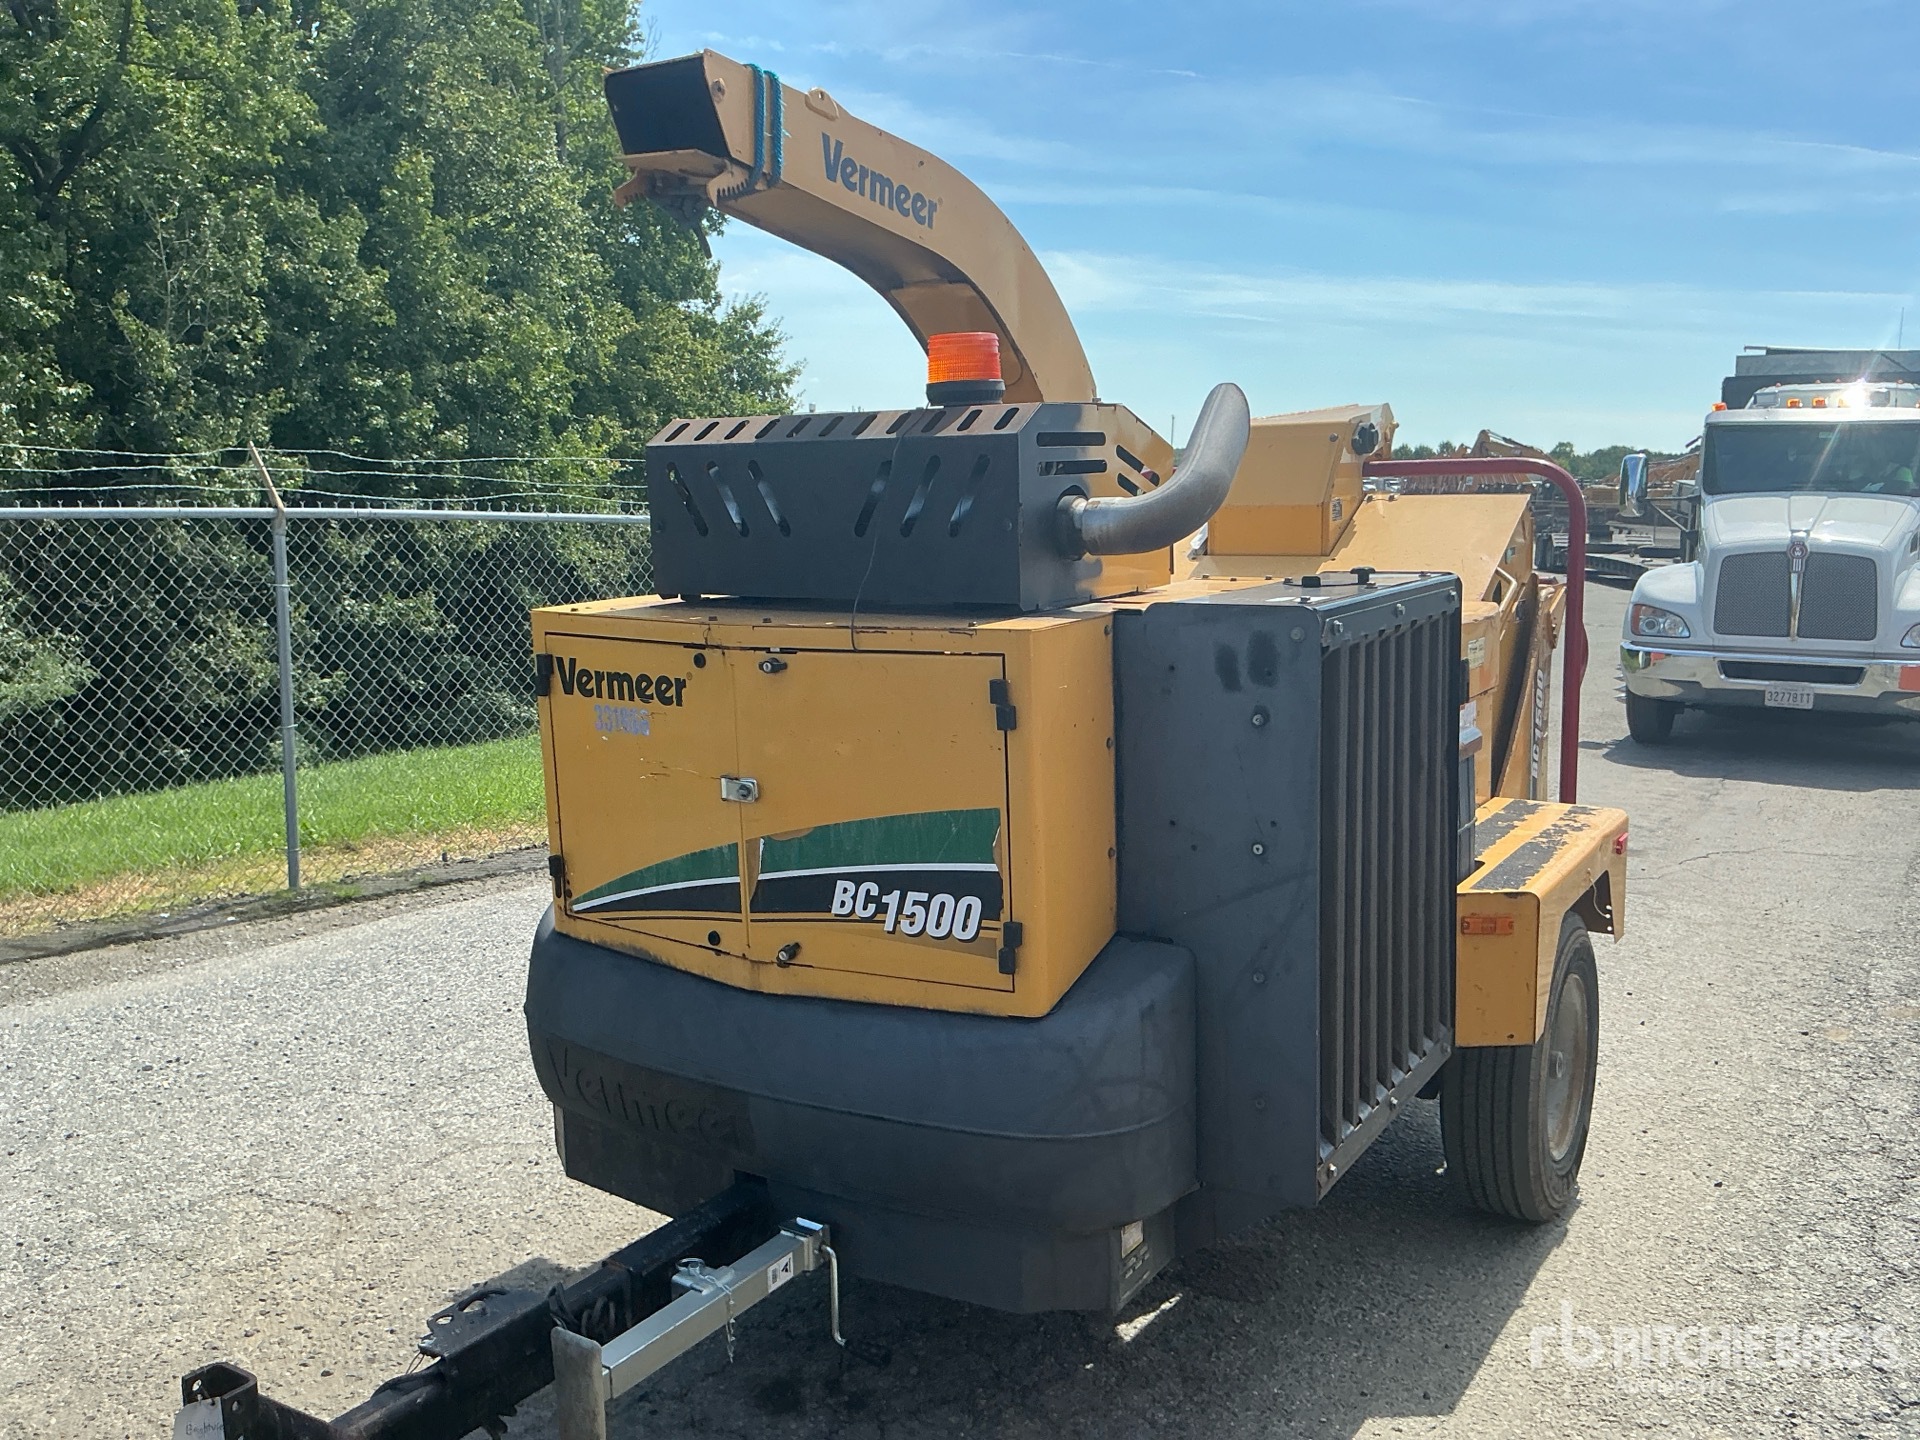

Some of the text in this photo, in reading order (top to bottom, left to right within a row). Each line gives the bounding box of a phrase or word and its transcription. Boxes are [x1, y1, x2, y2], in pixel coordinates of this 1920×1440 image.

[821, 131, 938, 229] Vermeer
[555, 656, 687, 707] Vermeer
[831, 879, 982, 941] BC1500
